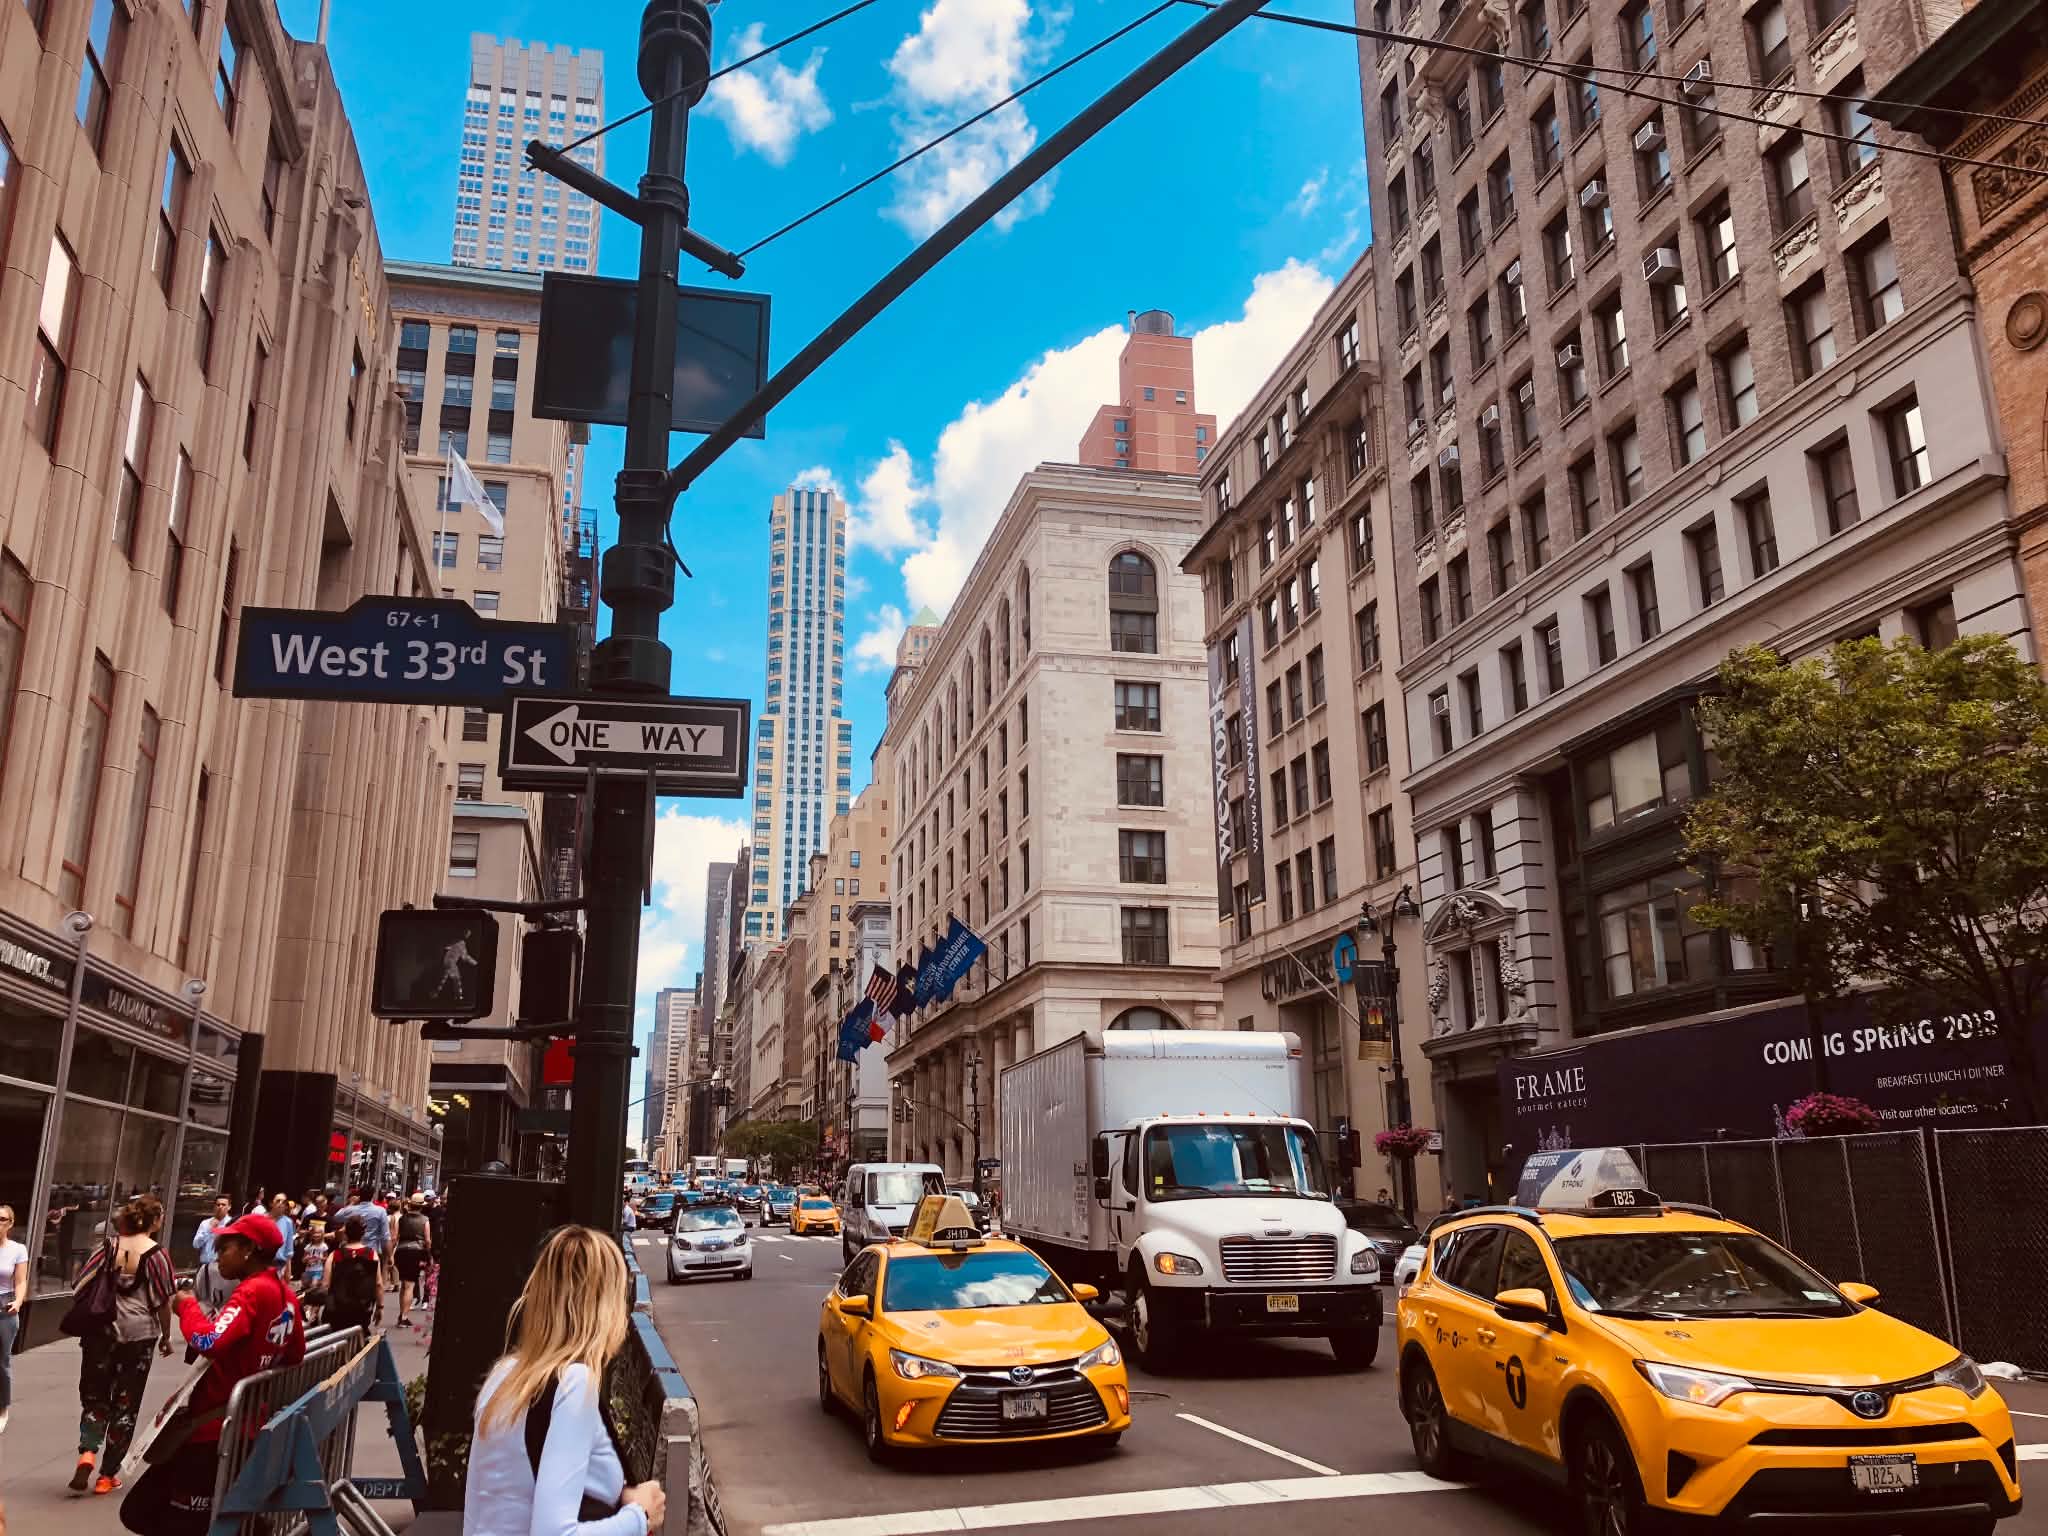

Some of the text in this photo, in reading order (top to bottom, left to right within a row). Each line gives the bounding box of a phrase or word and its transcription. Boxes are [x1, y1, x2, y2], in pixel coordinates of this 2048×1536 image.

[386, 611, 410, 627] 67
[271, 633, 547, 686] West 33rd St
[550, 721, 707, 753] ONE WAY
[1244, 656, 1260, 854] www.wework.com
[1209, 677, 1233, 869] wework
[1763, 1032, 1845, 1065] COMIG
[1852, 1018, 1935, 1053] SPRING
[1514, 1066, 1586, 1100] FRAME
[1876, 1073, 1923, 1089] BREAKFAST
[1929, 1069, 1961, 1084] LUNCH
[1517, 1101, 1553, 1116] gourmet
[1879, 1109, 1898, 1120] Visit
[1899, 1109, 1914, 1119] our
[1914, 1105, 1937, 1118] other
[1527, 1155, 1561, 1167] ADVERTISE
[1522, 1168, 1540, 1180] HERE
[1561, 1180, 1584, 1188] STRONG
[1611, 1191, 1636, 1206] 1B25
[214, 1306, 242, 1333] TOP
[362, 1482, 403, 1497] DEPT
[190, 1495, 210, 1507] VIE
